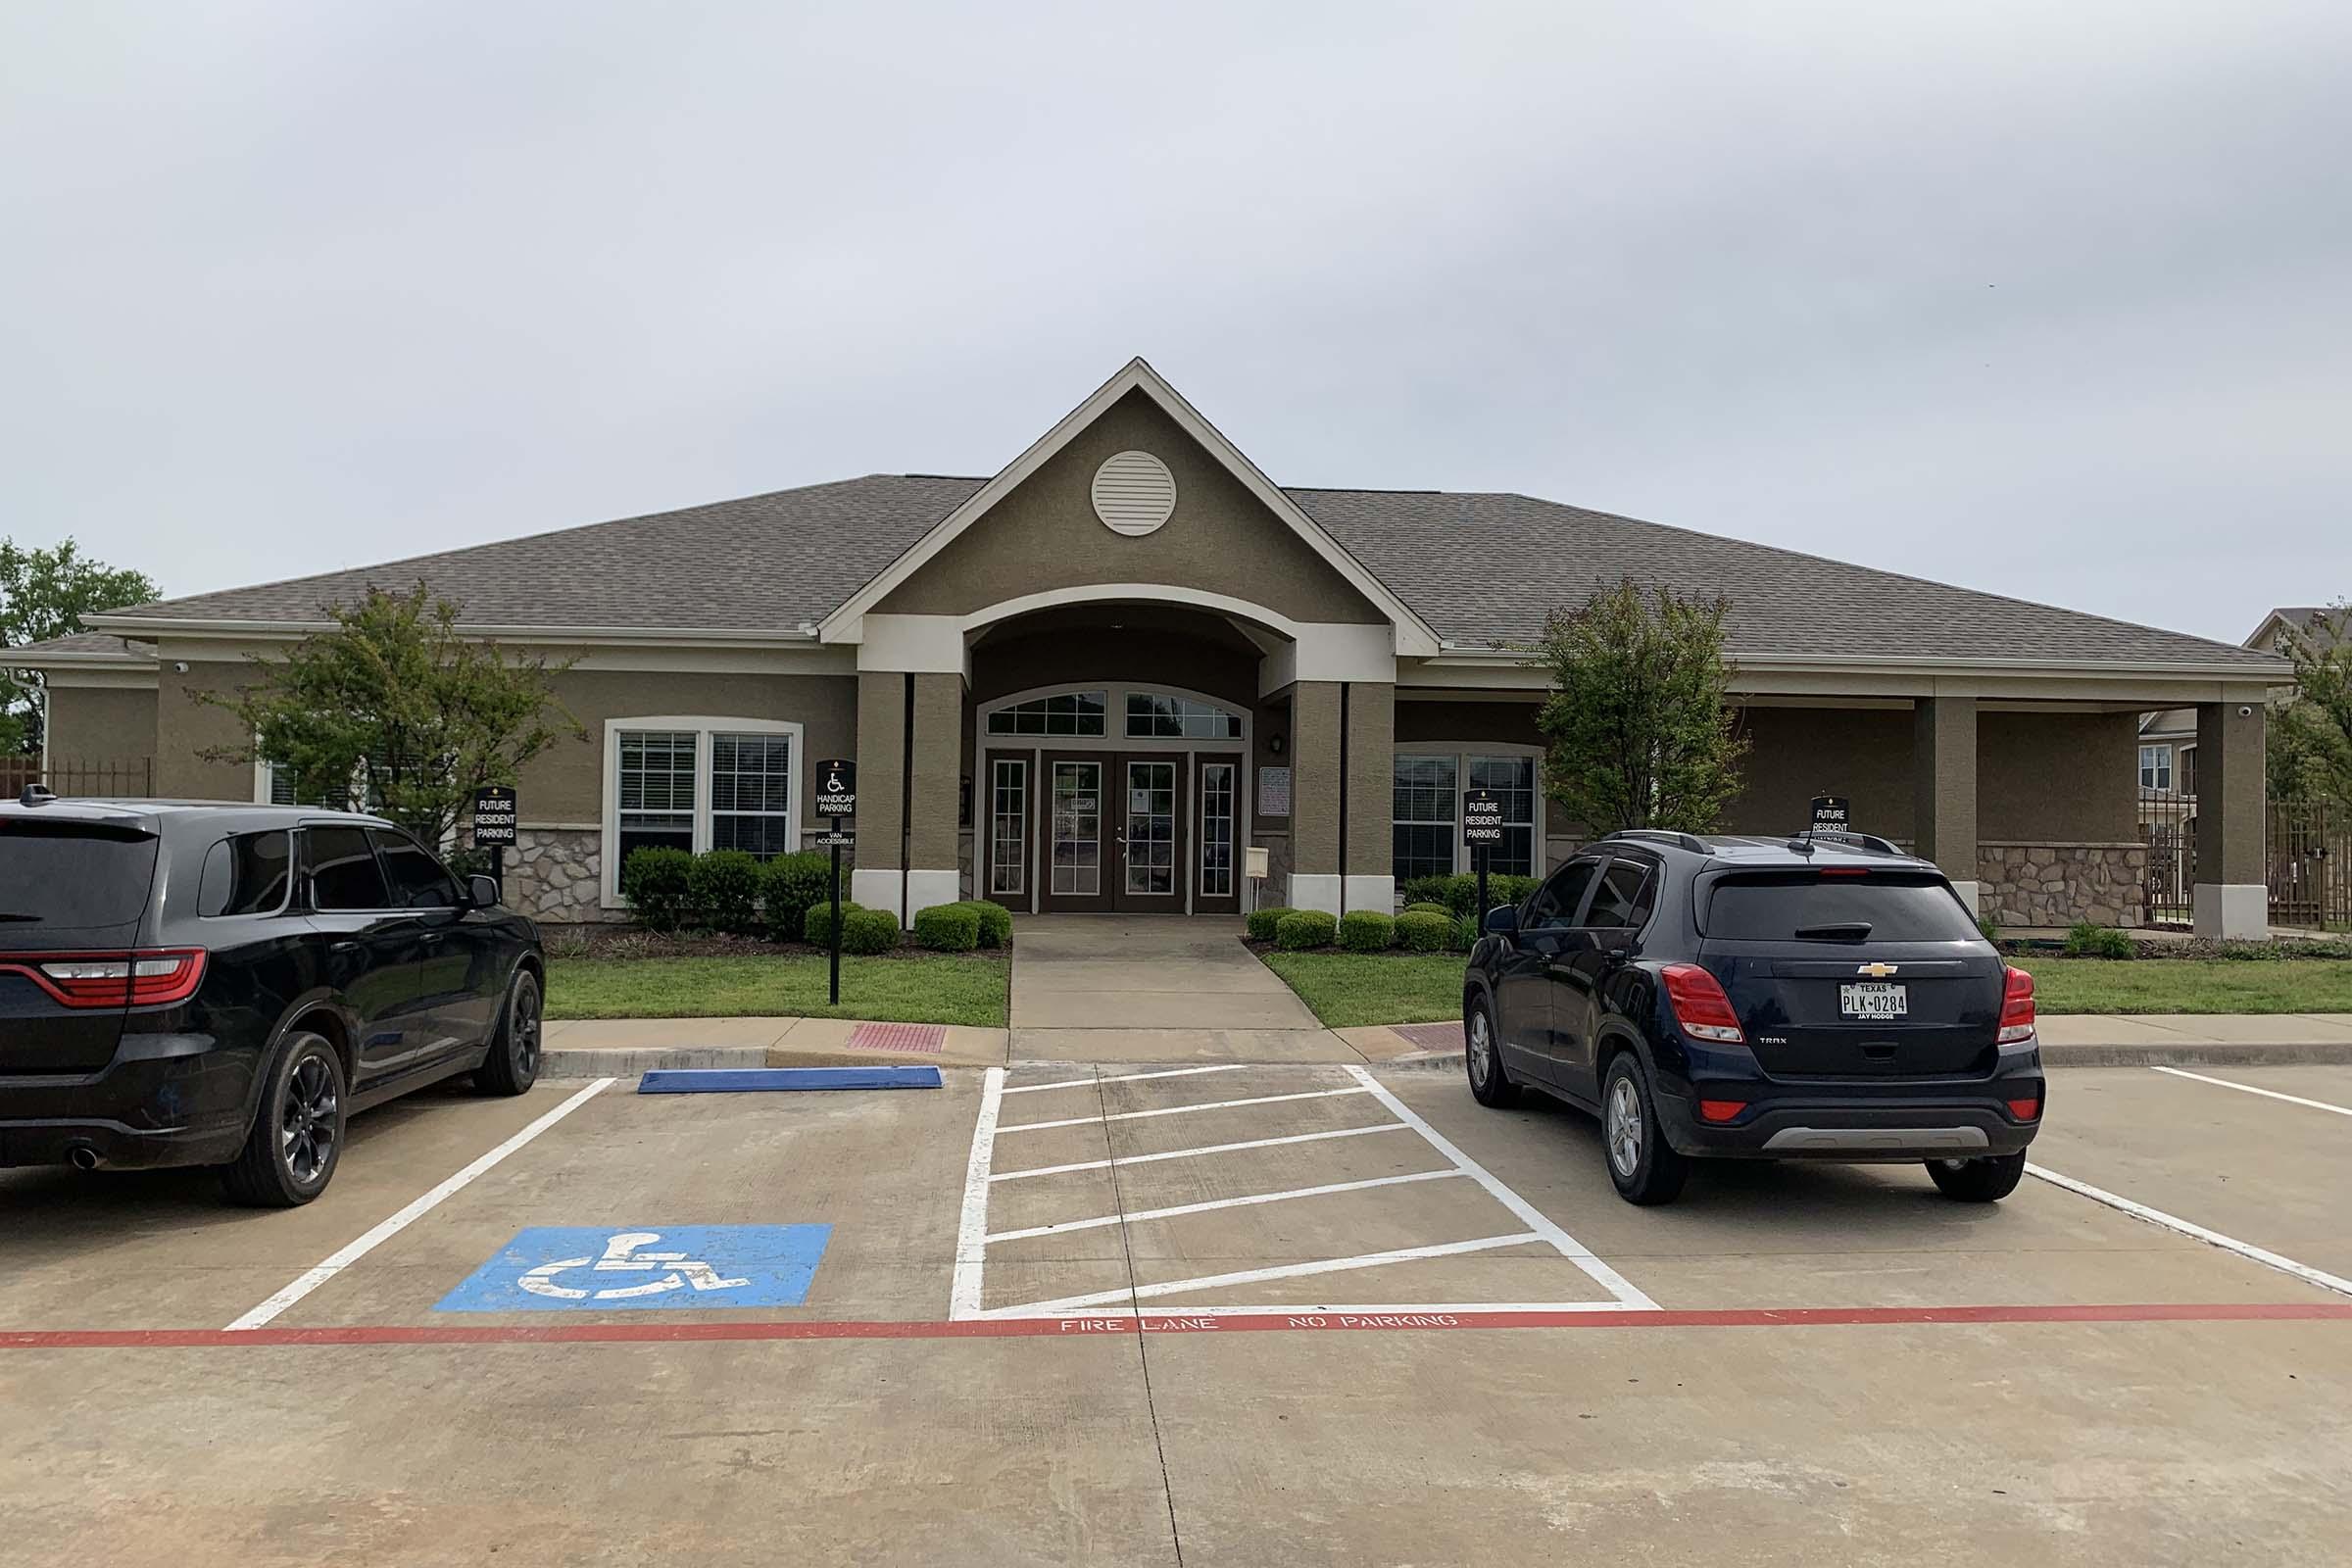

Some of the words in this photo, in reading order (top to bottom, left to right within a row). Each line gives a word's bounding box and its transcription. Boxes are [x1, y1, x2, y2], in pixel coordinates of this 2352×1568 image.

[816, 795, 856, 804] HANDICAP
[479, 800, 512, 810] FUTURE
[819, 804, 853, 812] PARKING
[1469, 803, 1498, 812] FUTURE
[475, 814, 515, 824] RESIDENT
[1816, 809, 1845, 819] FUTURE
[1465, 815, 1502, 825] RESIDENT
[1813, 822, 1848, 833] RESIDENT
[476, 828, 514, 838] PARKING
[1466, 829, 1500, 839] PARKING
[1860, 984, 1887, 993] TEXAS
[1060, 1319, 1125, 1332] FIRE
[1140, 1317, 1219, 1331] LANE
[1287, 1316, 1328, 1328] NO
[1340, 1314, 1458, 1328] PARKING
